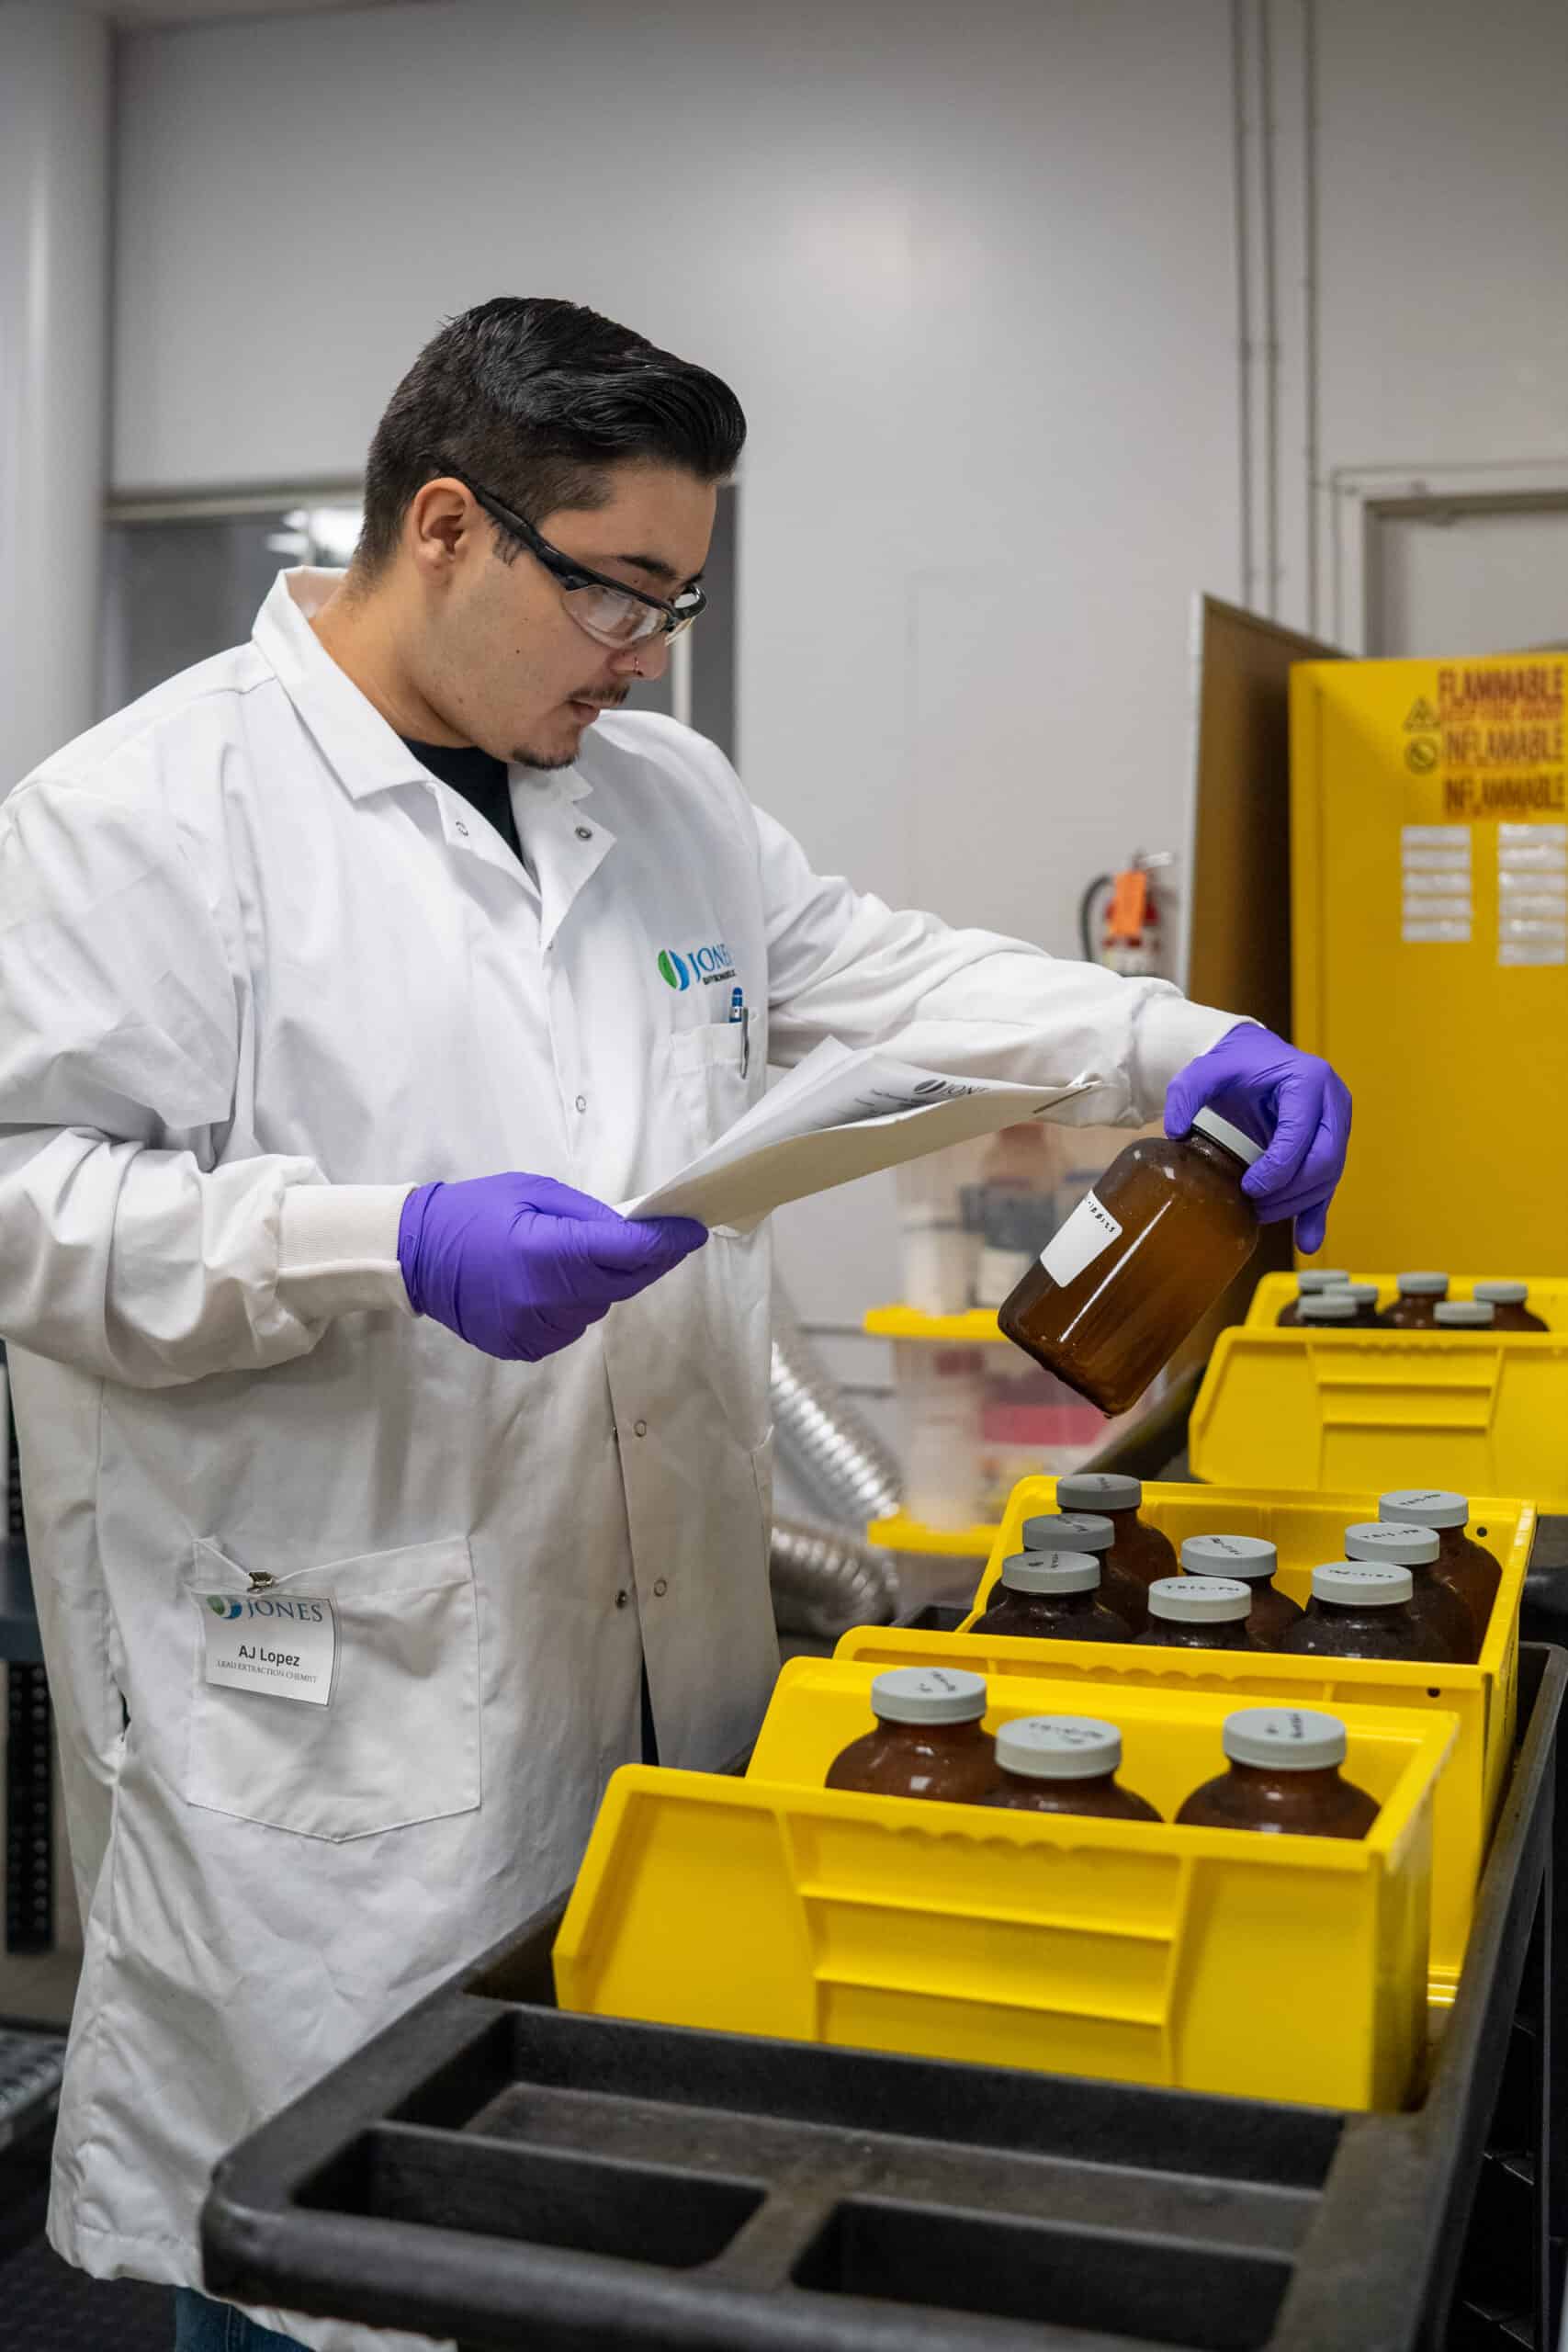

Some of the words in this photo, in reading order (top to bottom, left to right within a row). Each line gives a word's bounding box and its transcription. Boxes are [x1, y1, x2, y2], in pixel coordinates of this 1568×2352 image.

[1438, 665, 1563, 703] FLAMMABLE
[247, 1599, 323, 1623] JONES
[239, 1645, 256, 1659] AJ
[260, 1647, 300, 1668] Lopez
[216, 1660, 237, 1669] LEAD
[238, 1663, 285, 1677] EXTRACTION
[286, 1669, 318, 1684] CHEMIST
